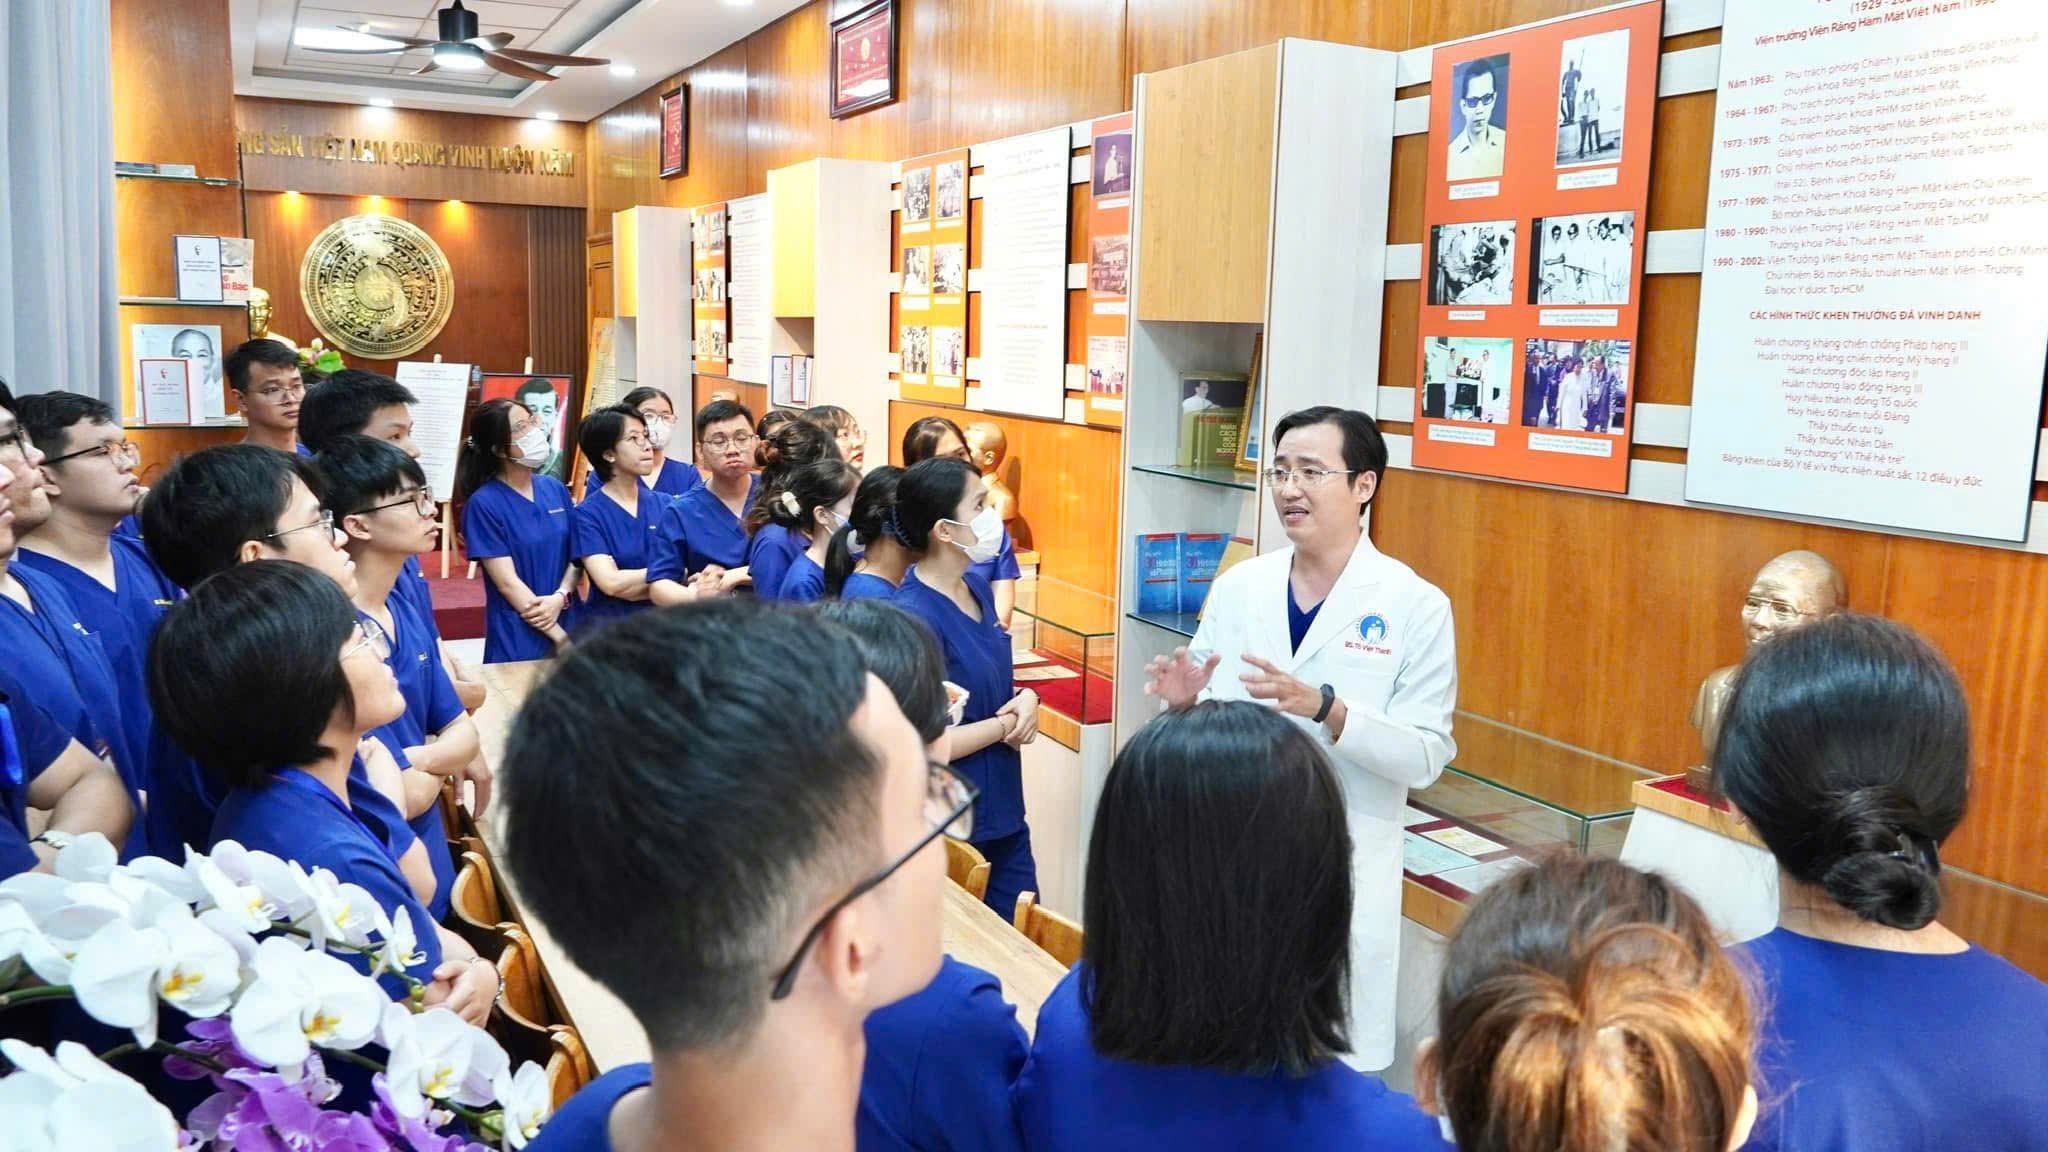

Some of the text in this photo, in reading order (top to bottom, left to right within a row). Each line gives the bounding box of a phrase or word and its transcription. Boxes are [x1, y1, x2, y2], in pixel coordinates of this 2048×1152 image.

[1932, 1, 1960, 14] Nam
[351, 138, 387, 164] NAM
[391, 142, 446, 169] QUANG
[448, 143, 484, 169] VINH
[1823, 309, 1848, 319] KHEN
[1917, 309, 1944, 320] VINH
[1947, 309, 1981, 320] DANH
